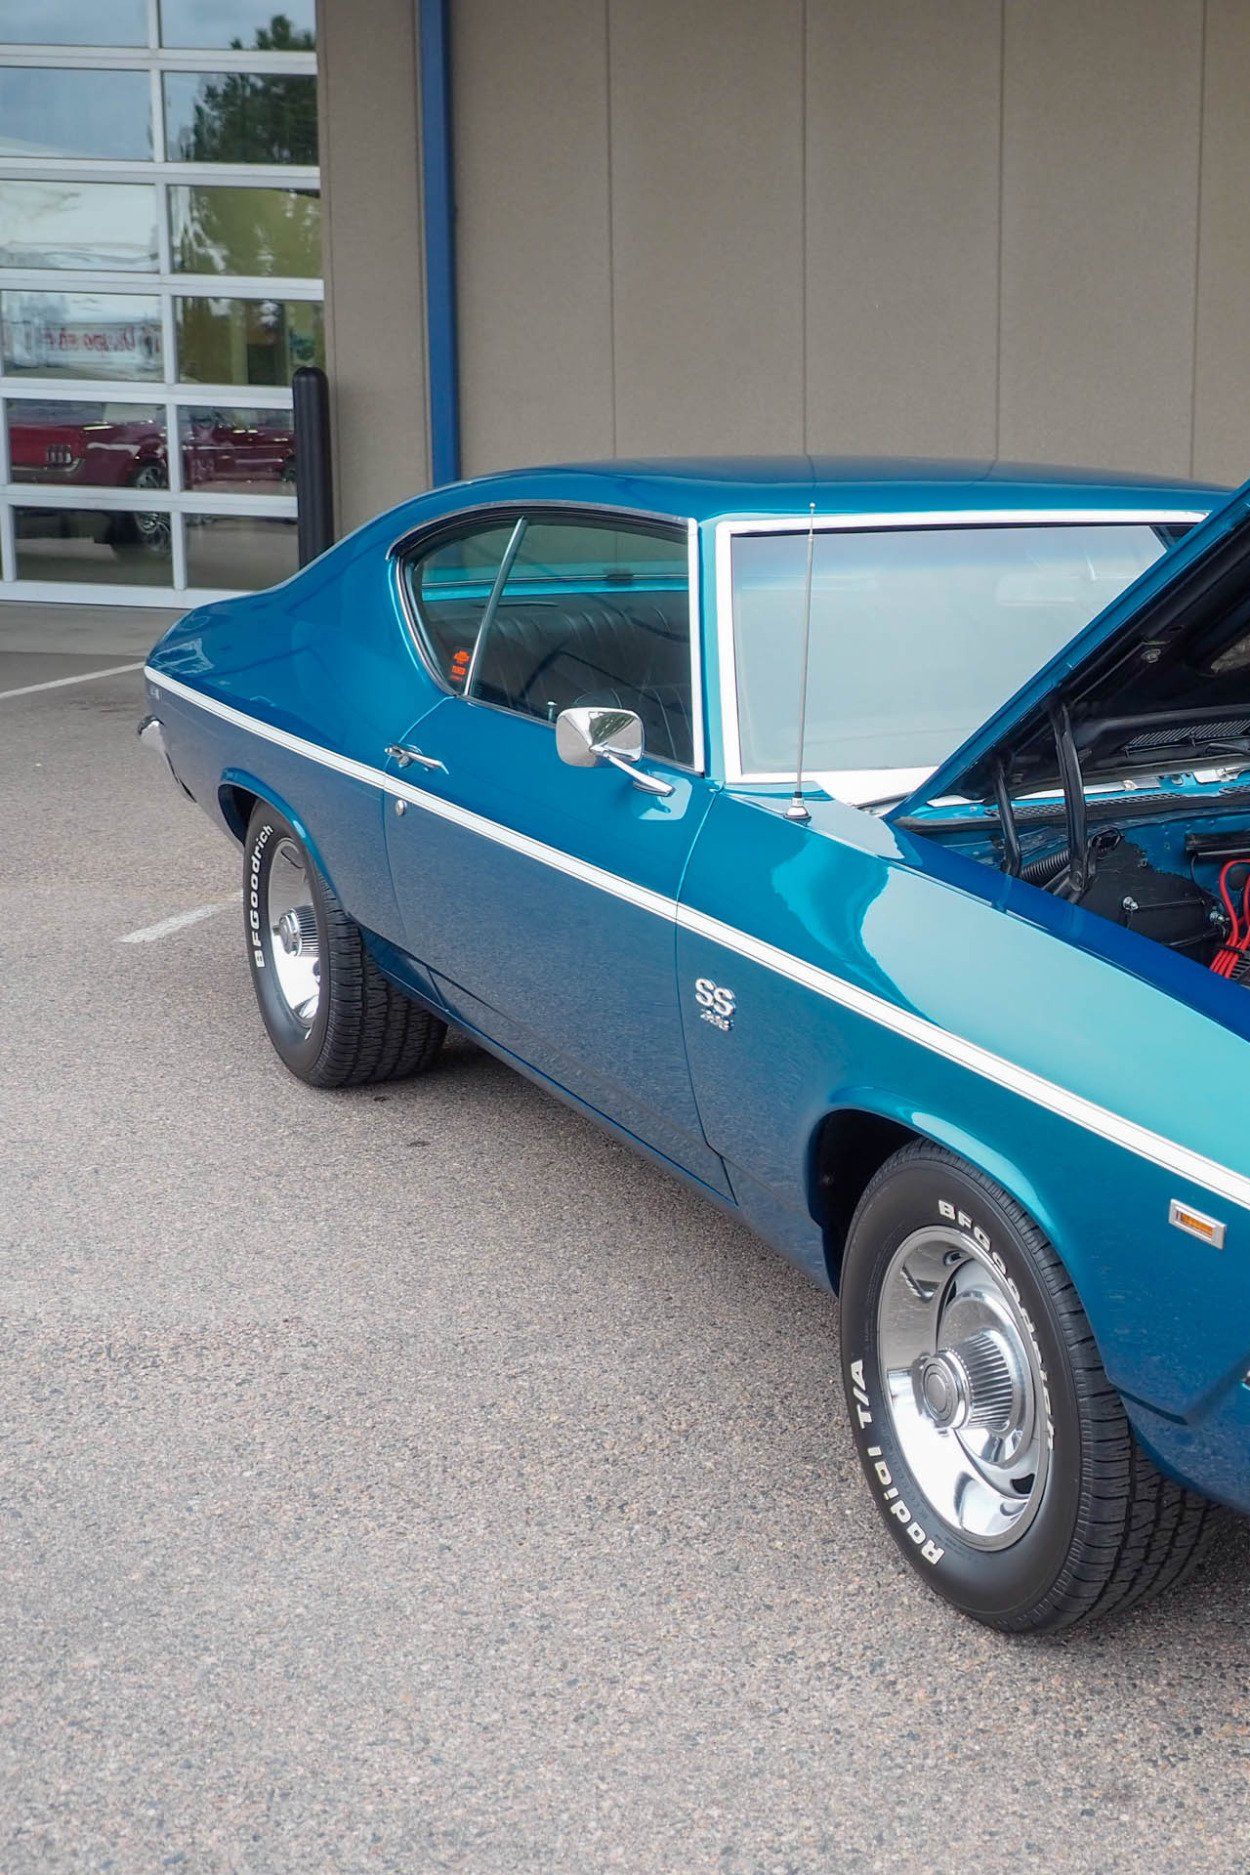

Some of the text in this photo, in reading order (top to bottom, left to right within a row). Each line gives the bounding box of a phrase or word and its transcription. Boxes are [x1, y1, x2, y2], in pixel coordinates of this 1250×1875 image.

[250, 823, 274, 969] BFGoodrich
[695, 978, 736, 1017] SS
[850, 1358, 946, 1566] Radial T/A
